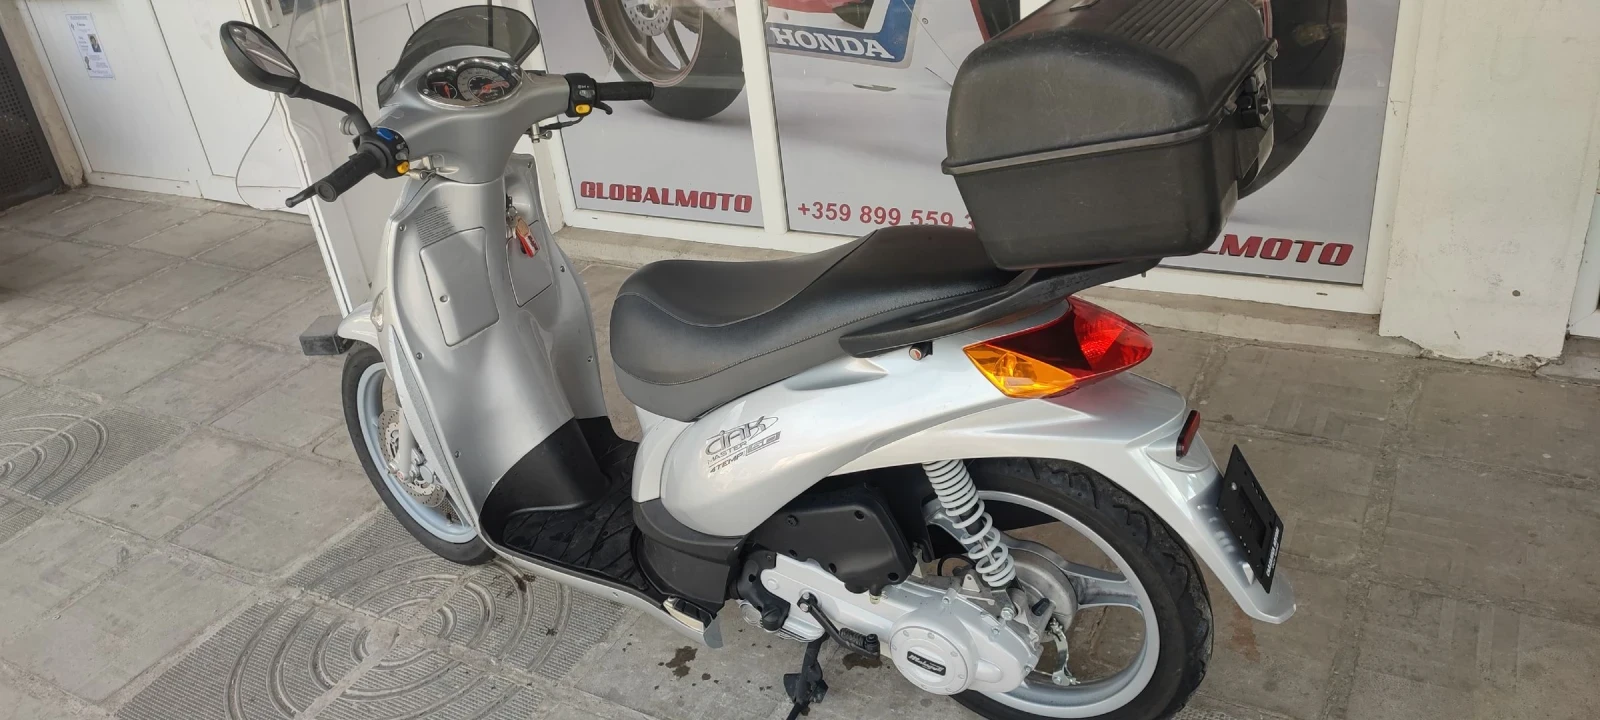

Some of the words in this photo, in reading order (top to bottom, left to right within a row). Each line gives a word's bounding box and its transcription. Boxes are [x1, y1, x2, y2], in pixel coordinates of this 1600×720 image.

[769, 27, 895, 60] HONDA
[580, 181, 753, 213] GLOBALMOTO
[797, 201, 852, 222] +359
[859, 205, 901, 226] 899
[910, 209, 954, 228] 559
